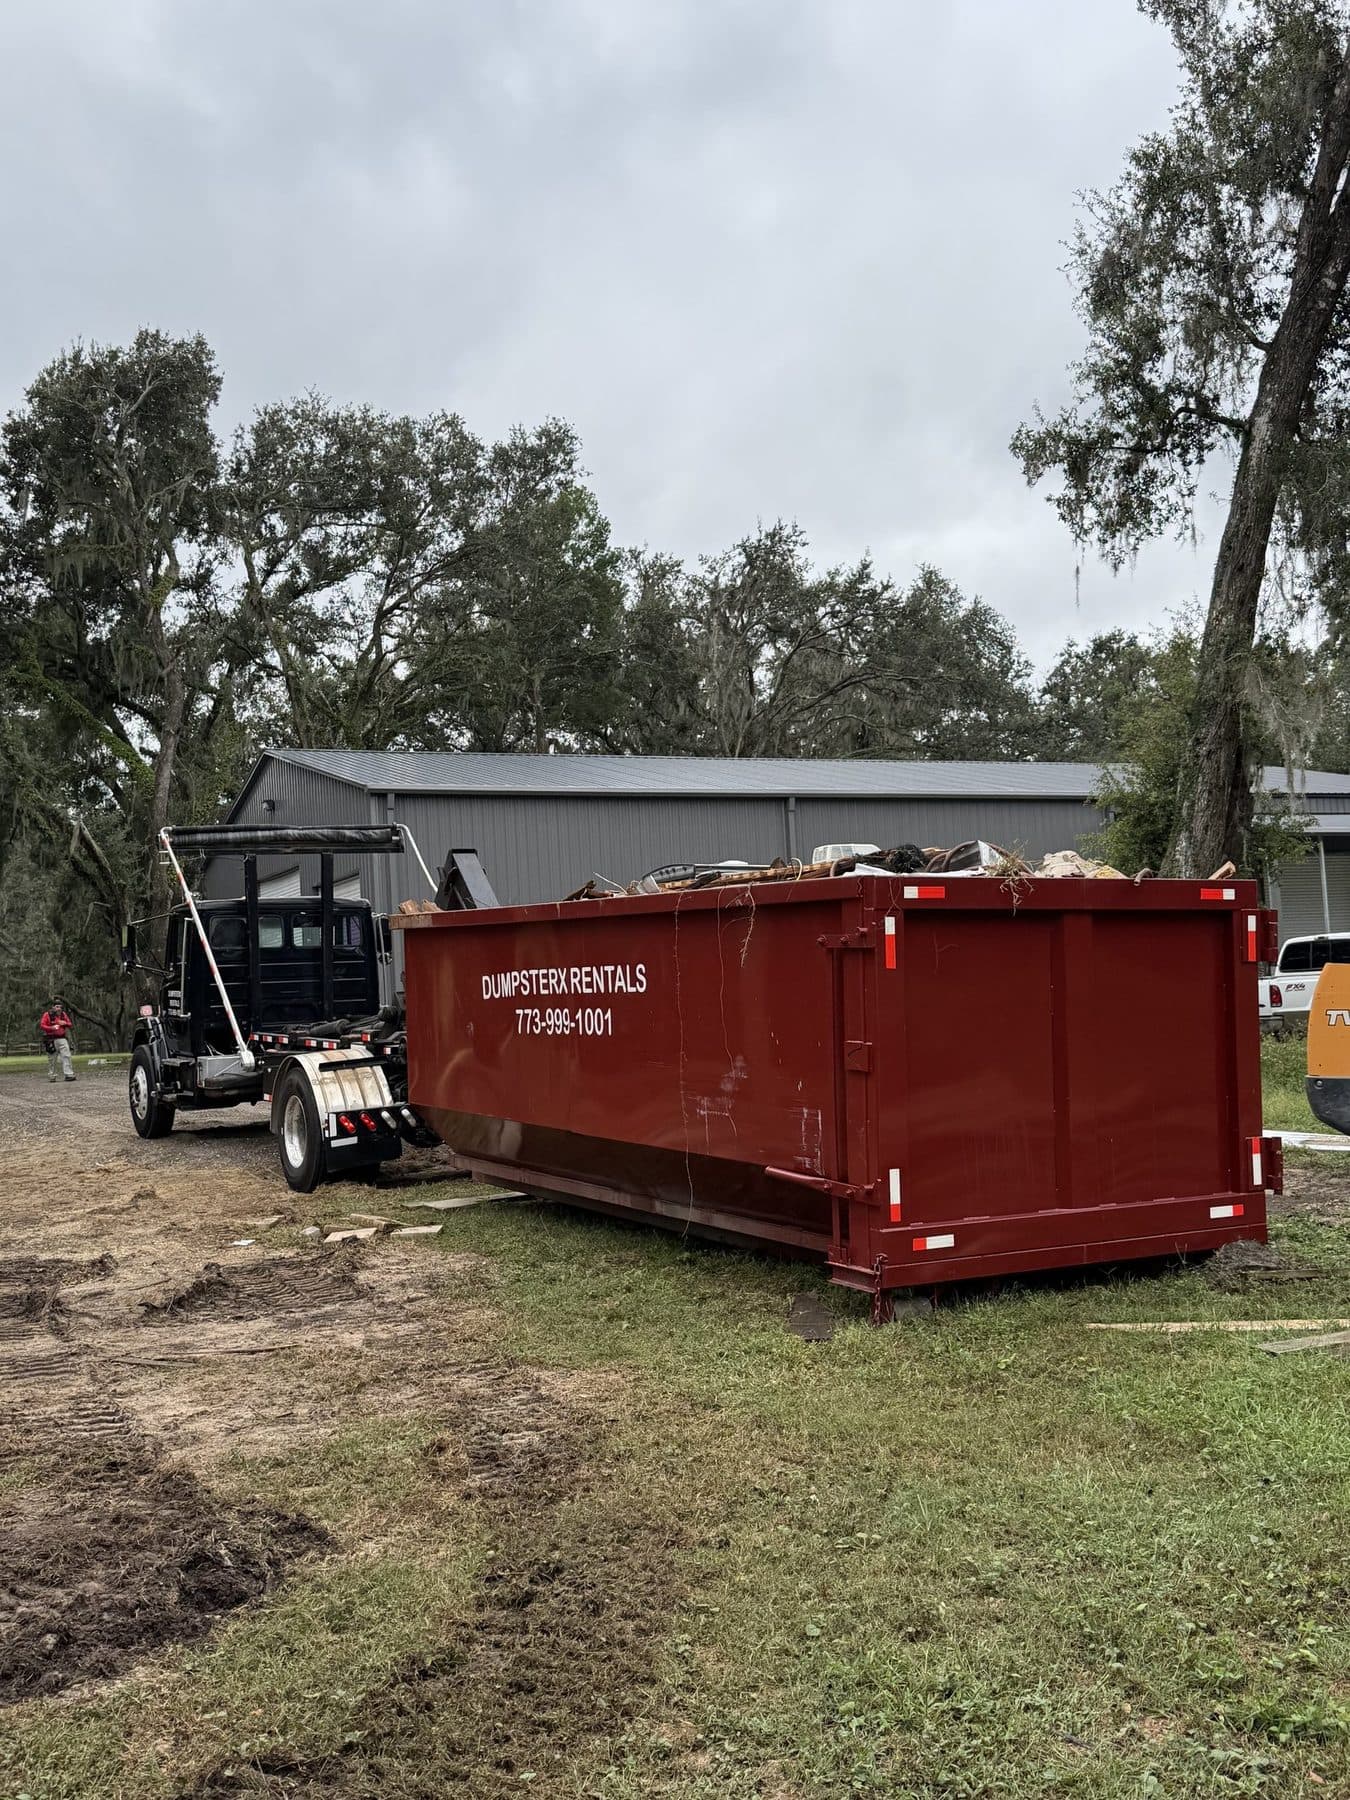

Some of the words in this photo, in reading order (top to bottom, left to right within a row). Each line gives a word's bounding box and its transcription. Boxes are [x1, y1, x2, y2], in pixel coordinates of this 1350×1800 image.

[482, 968, 569, 1000] DUMPSTERX
[571, 964, 647, 994] RENTALS
[515, 1008, 613, 1036] 773-999-1001
